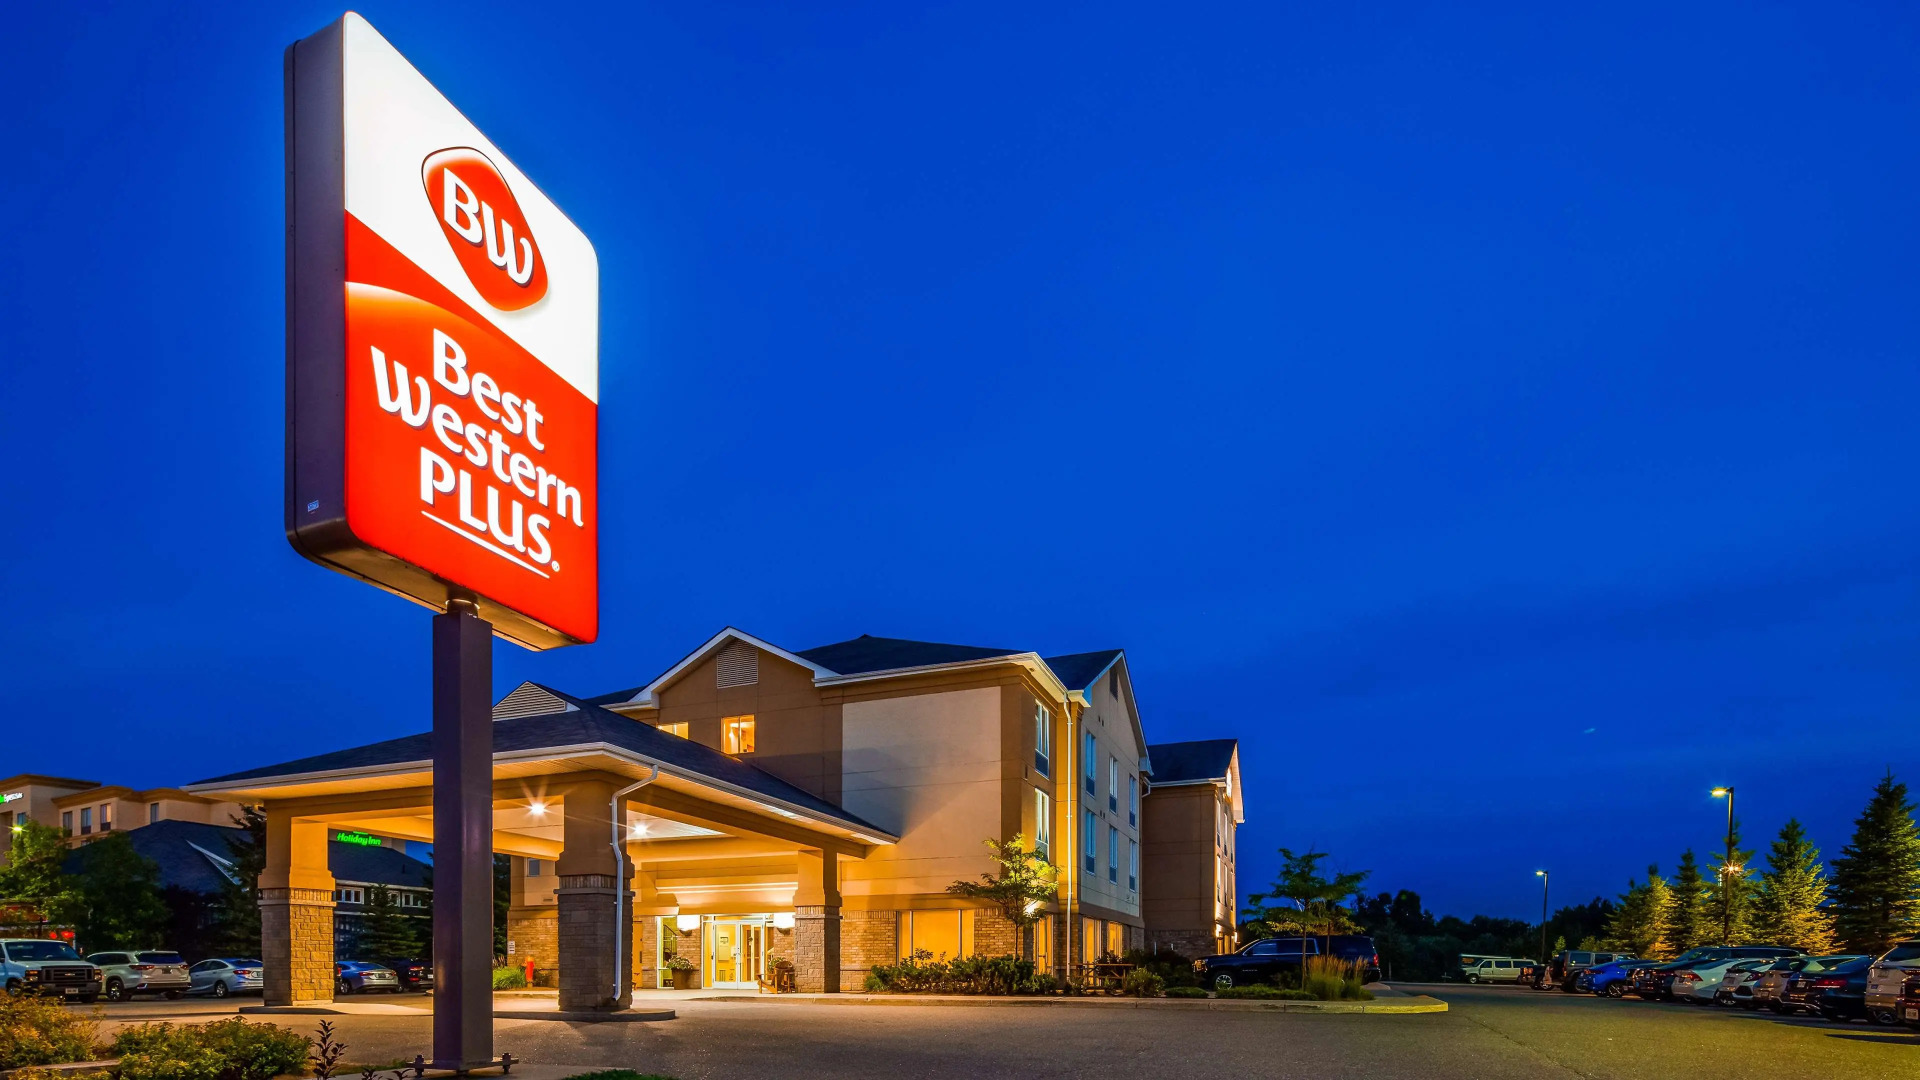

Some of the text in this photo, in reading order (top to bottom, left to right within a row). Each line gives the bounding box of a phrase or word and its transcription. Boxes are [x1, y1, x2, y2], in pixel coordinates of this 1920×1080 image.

[444, 168, 533, 284] BW
[370, 345, 584, 527] Western
[433, 328, 545, 451] Best
[337, 833, 381, 846] Holiday Inn
